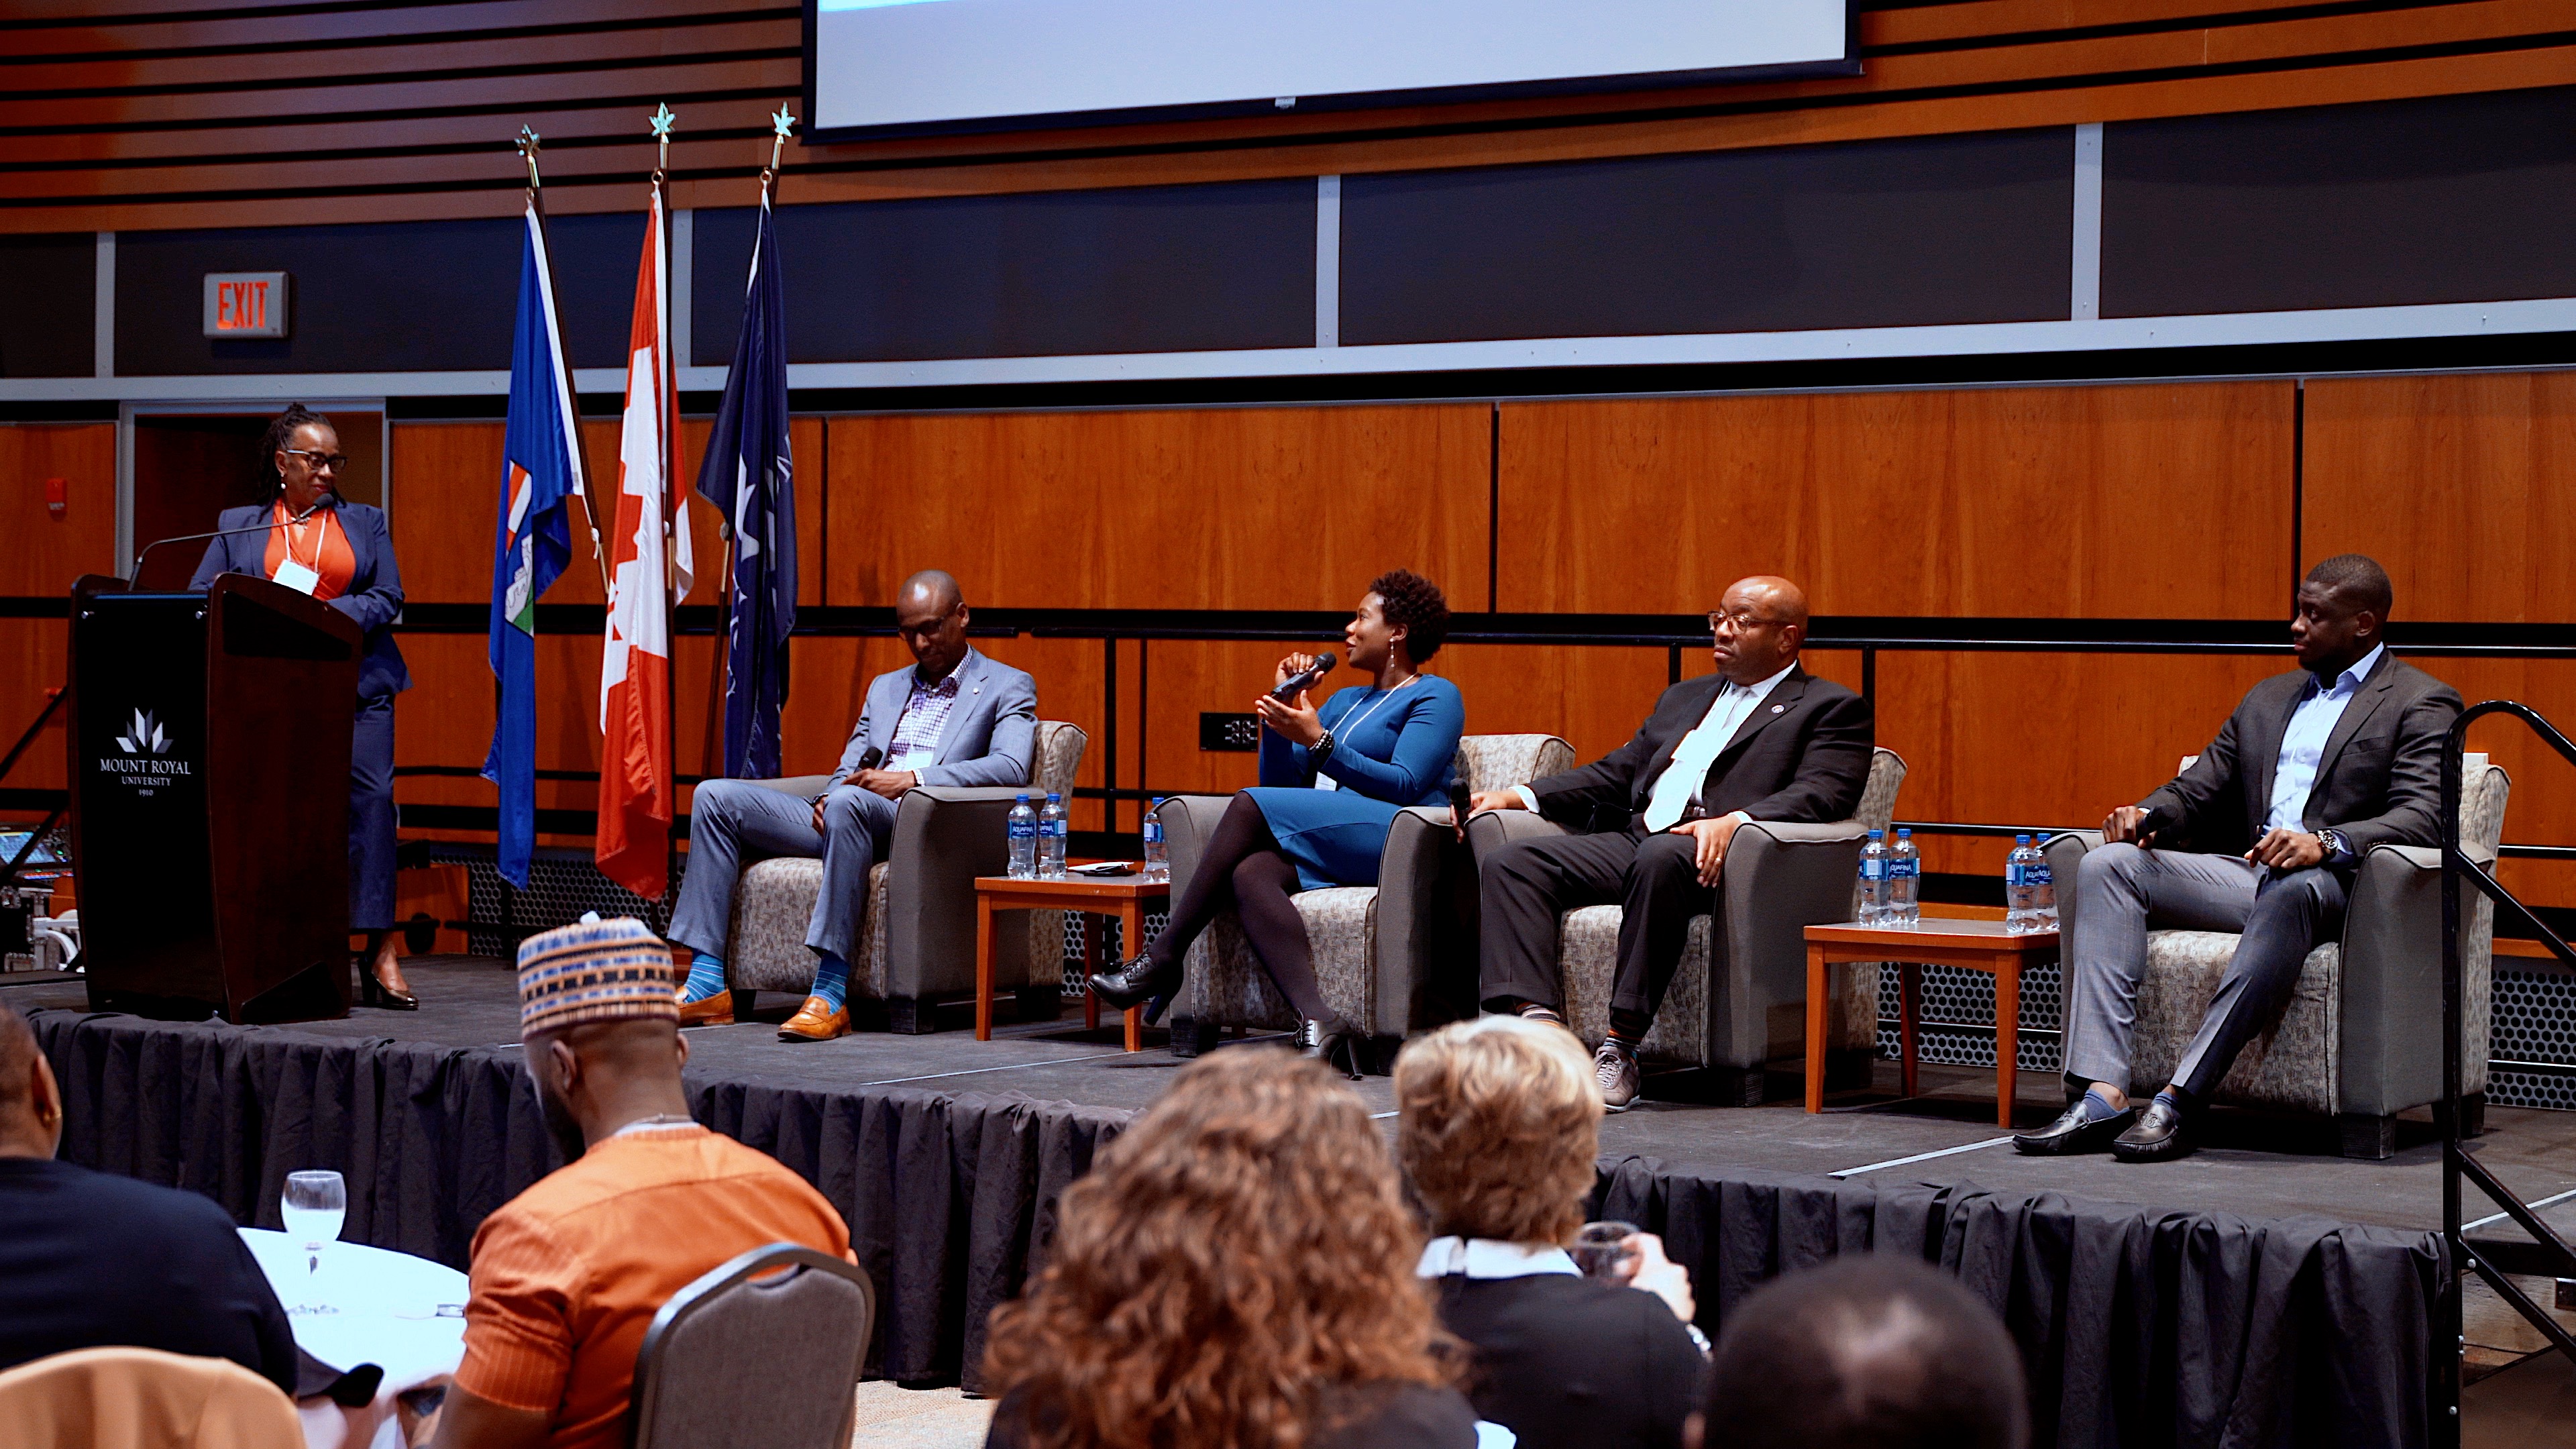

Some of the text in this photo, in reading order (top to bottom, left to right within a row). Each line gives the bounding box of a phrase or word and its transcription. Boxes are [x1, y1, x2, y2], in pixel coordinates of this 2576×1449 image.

[217, 280, 269, 329] EXIT
[100, 758, 191, 775] MOUNT ROYAL
[121, 776, 171, 786] UNIVERSITY
[138, 789, 154, 797] 1910
